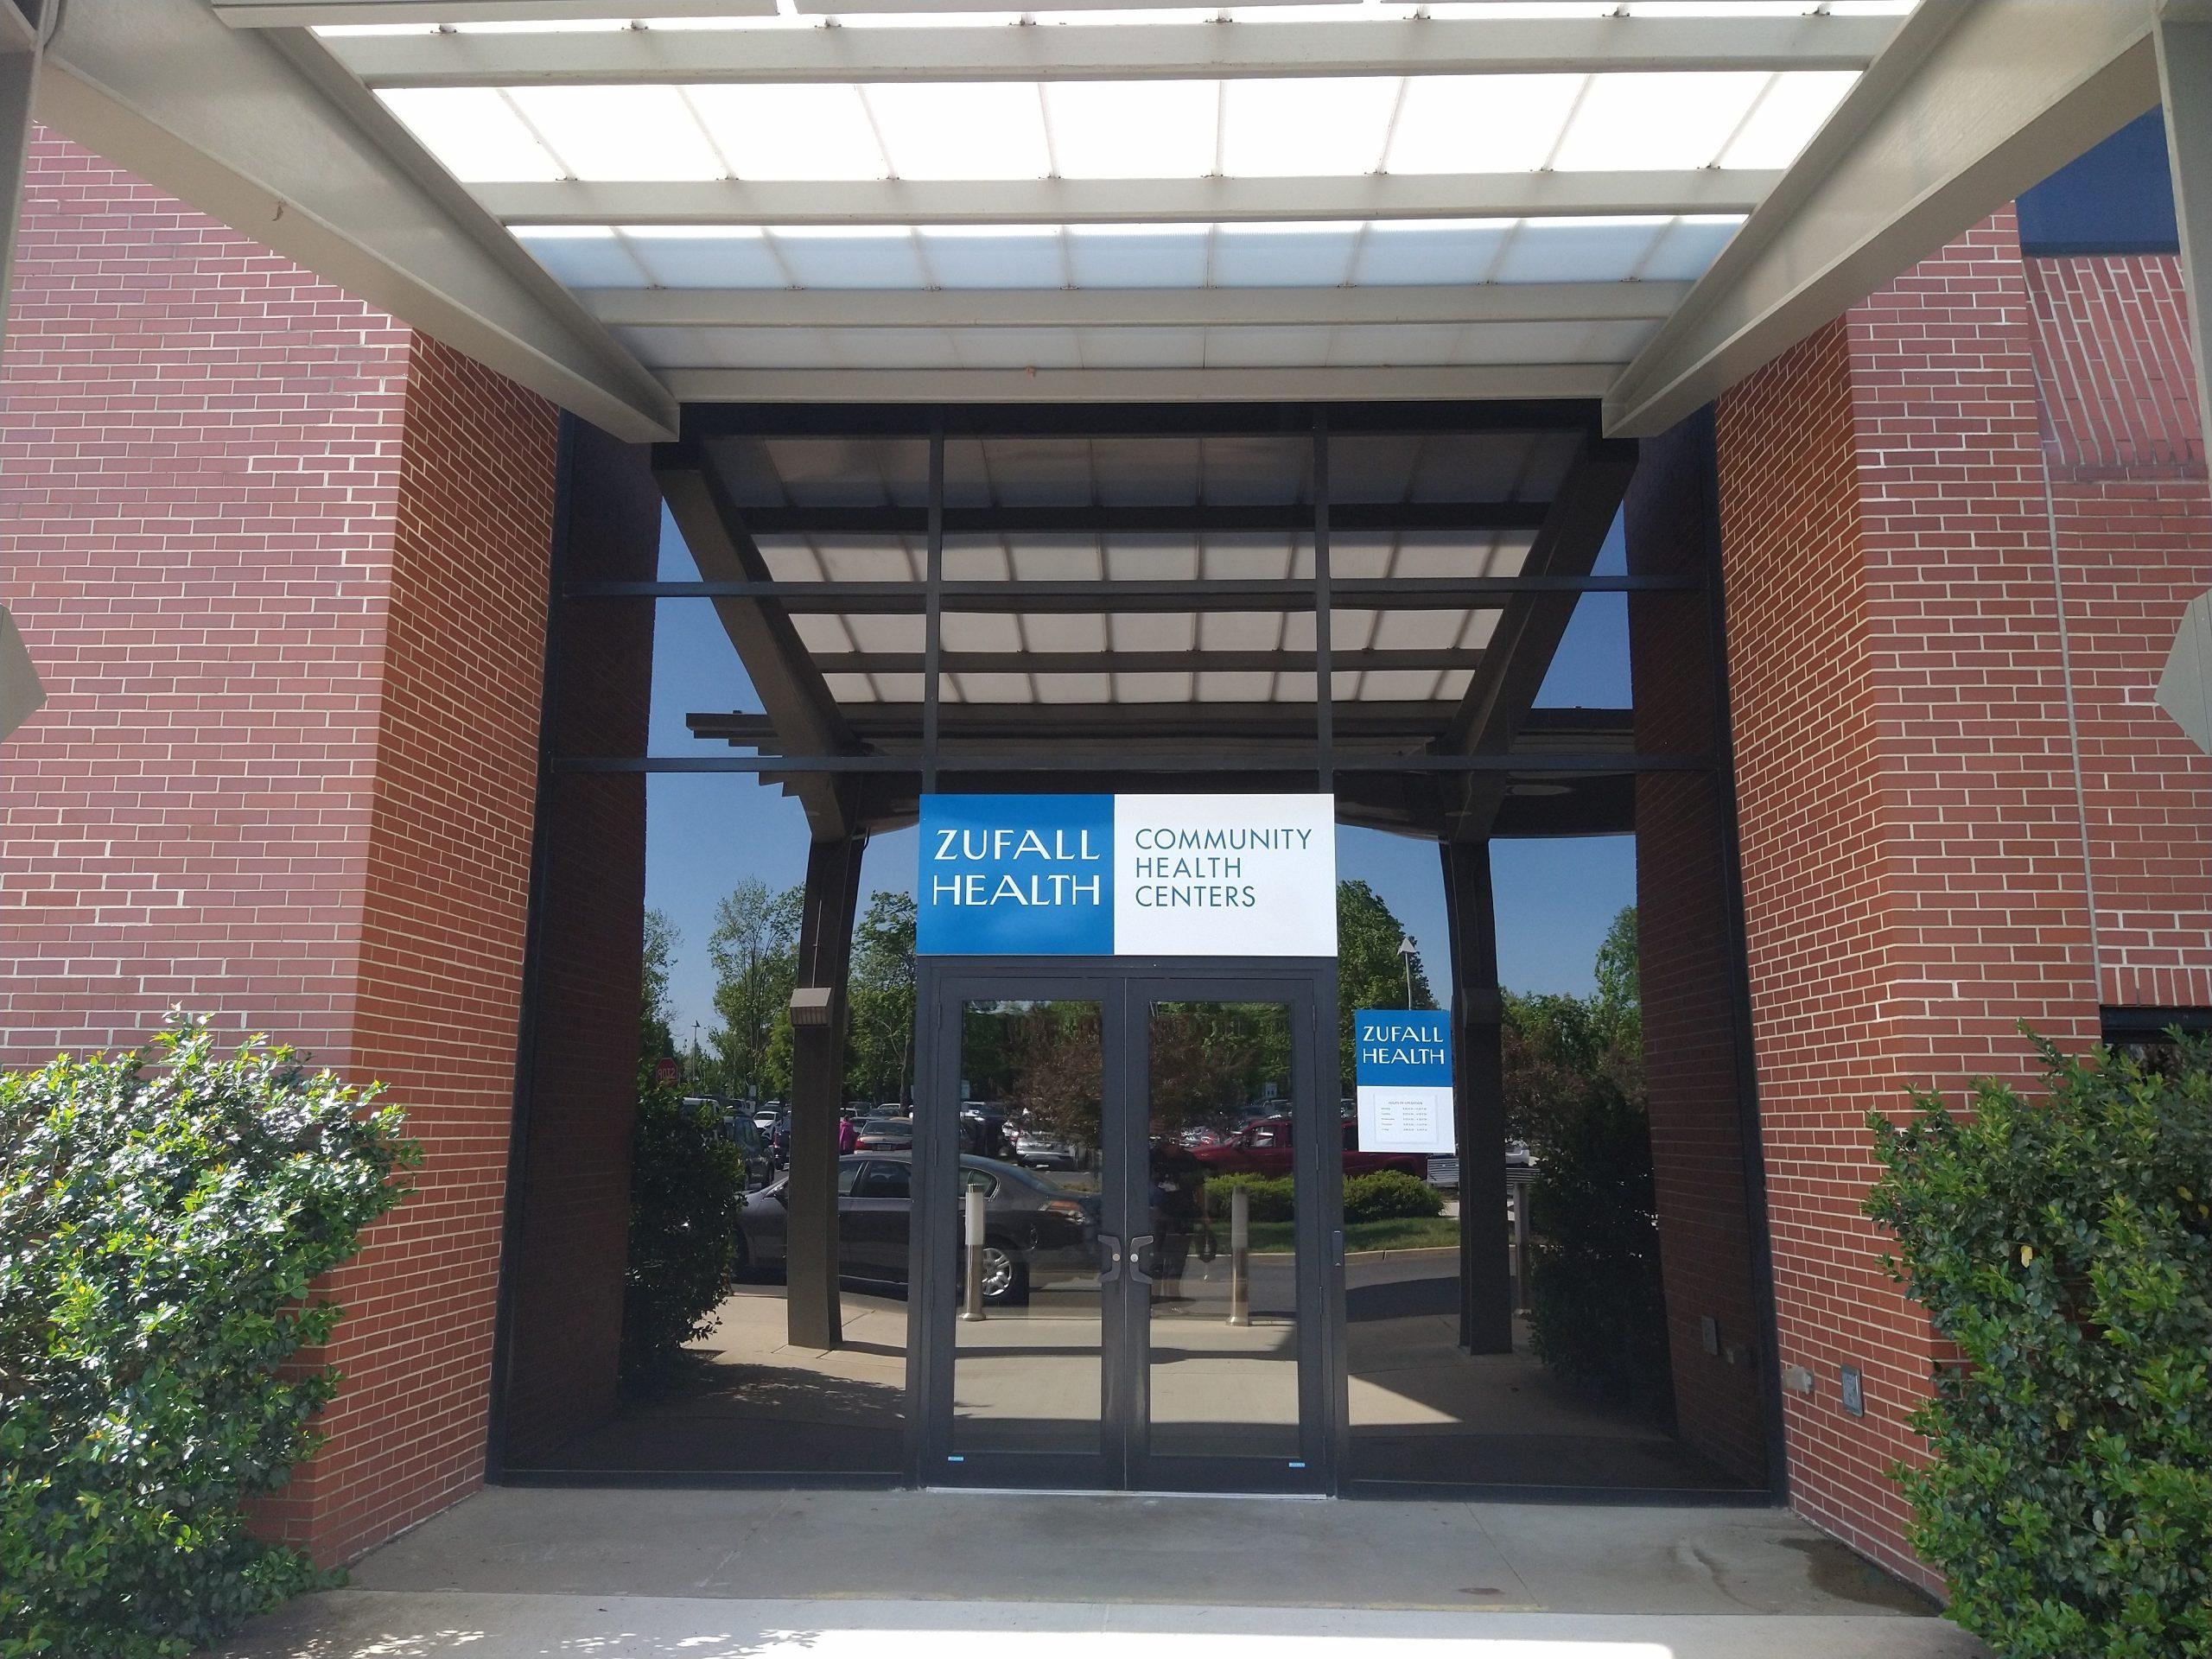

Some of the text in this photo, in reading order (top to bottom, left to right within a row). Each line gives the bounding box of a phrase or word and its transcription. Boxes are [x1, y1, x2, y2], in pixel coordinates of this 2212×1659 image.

[934, 829, 1101, 861] ZUFALL
[1135, 828, 1313, 850] COMMUNITY
[1135, 857, 1243, 879] HEALTH
[932, 874, 1100, 906] HEALTH
[1135, 886, 1256, 907] CENTERS
[1363, 1026, 1444, 1043] ZUFALL
[1363, 1048, 1445, 1065] HEALTH
